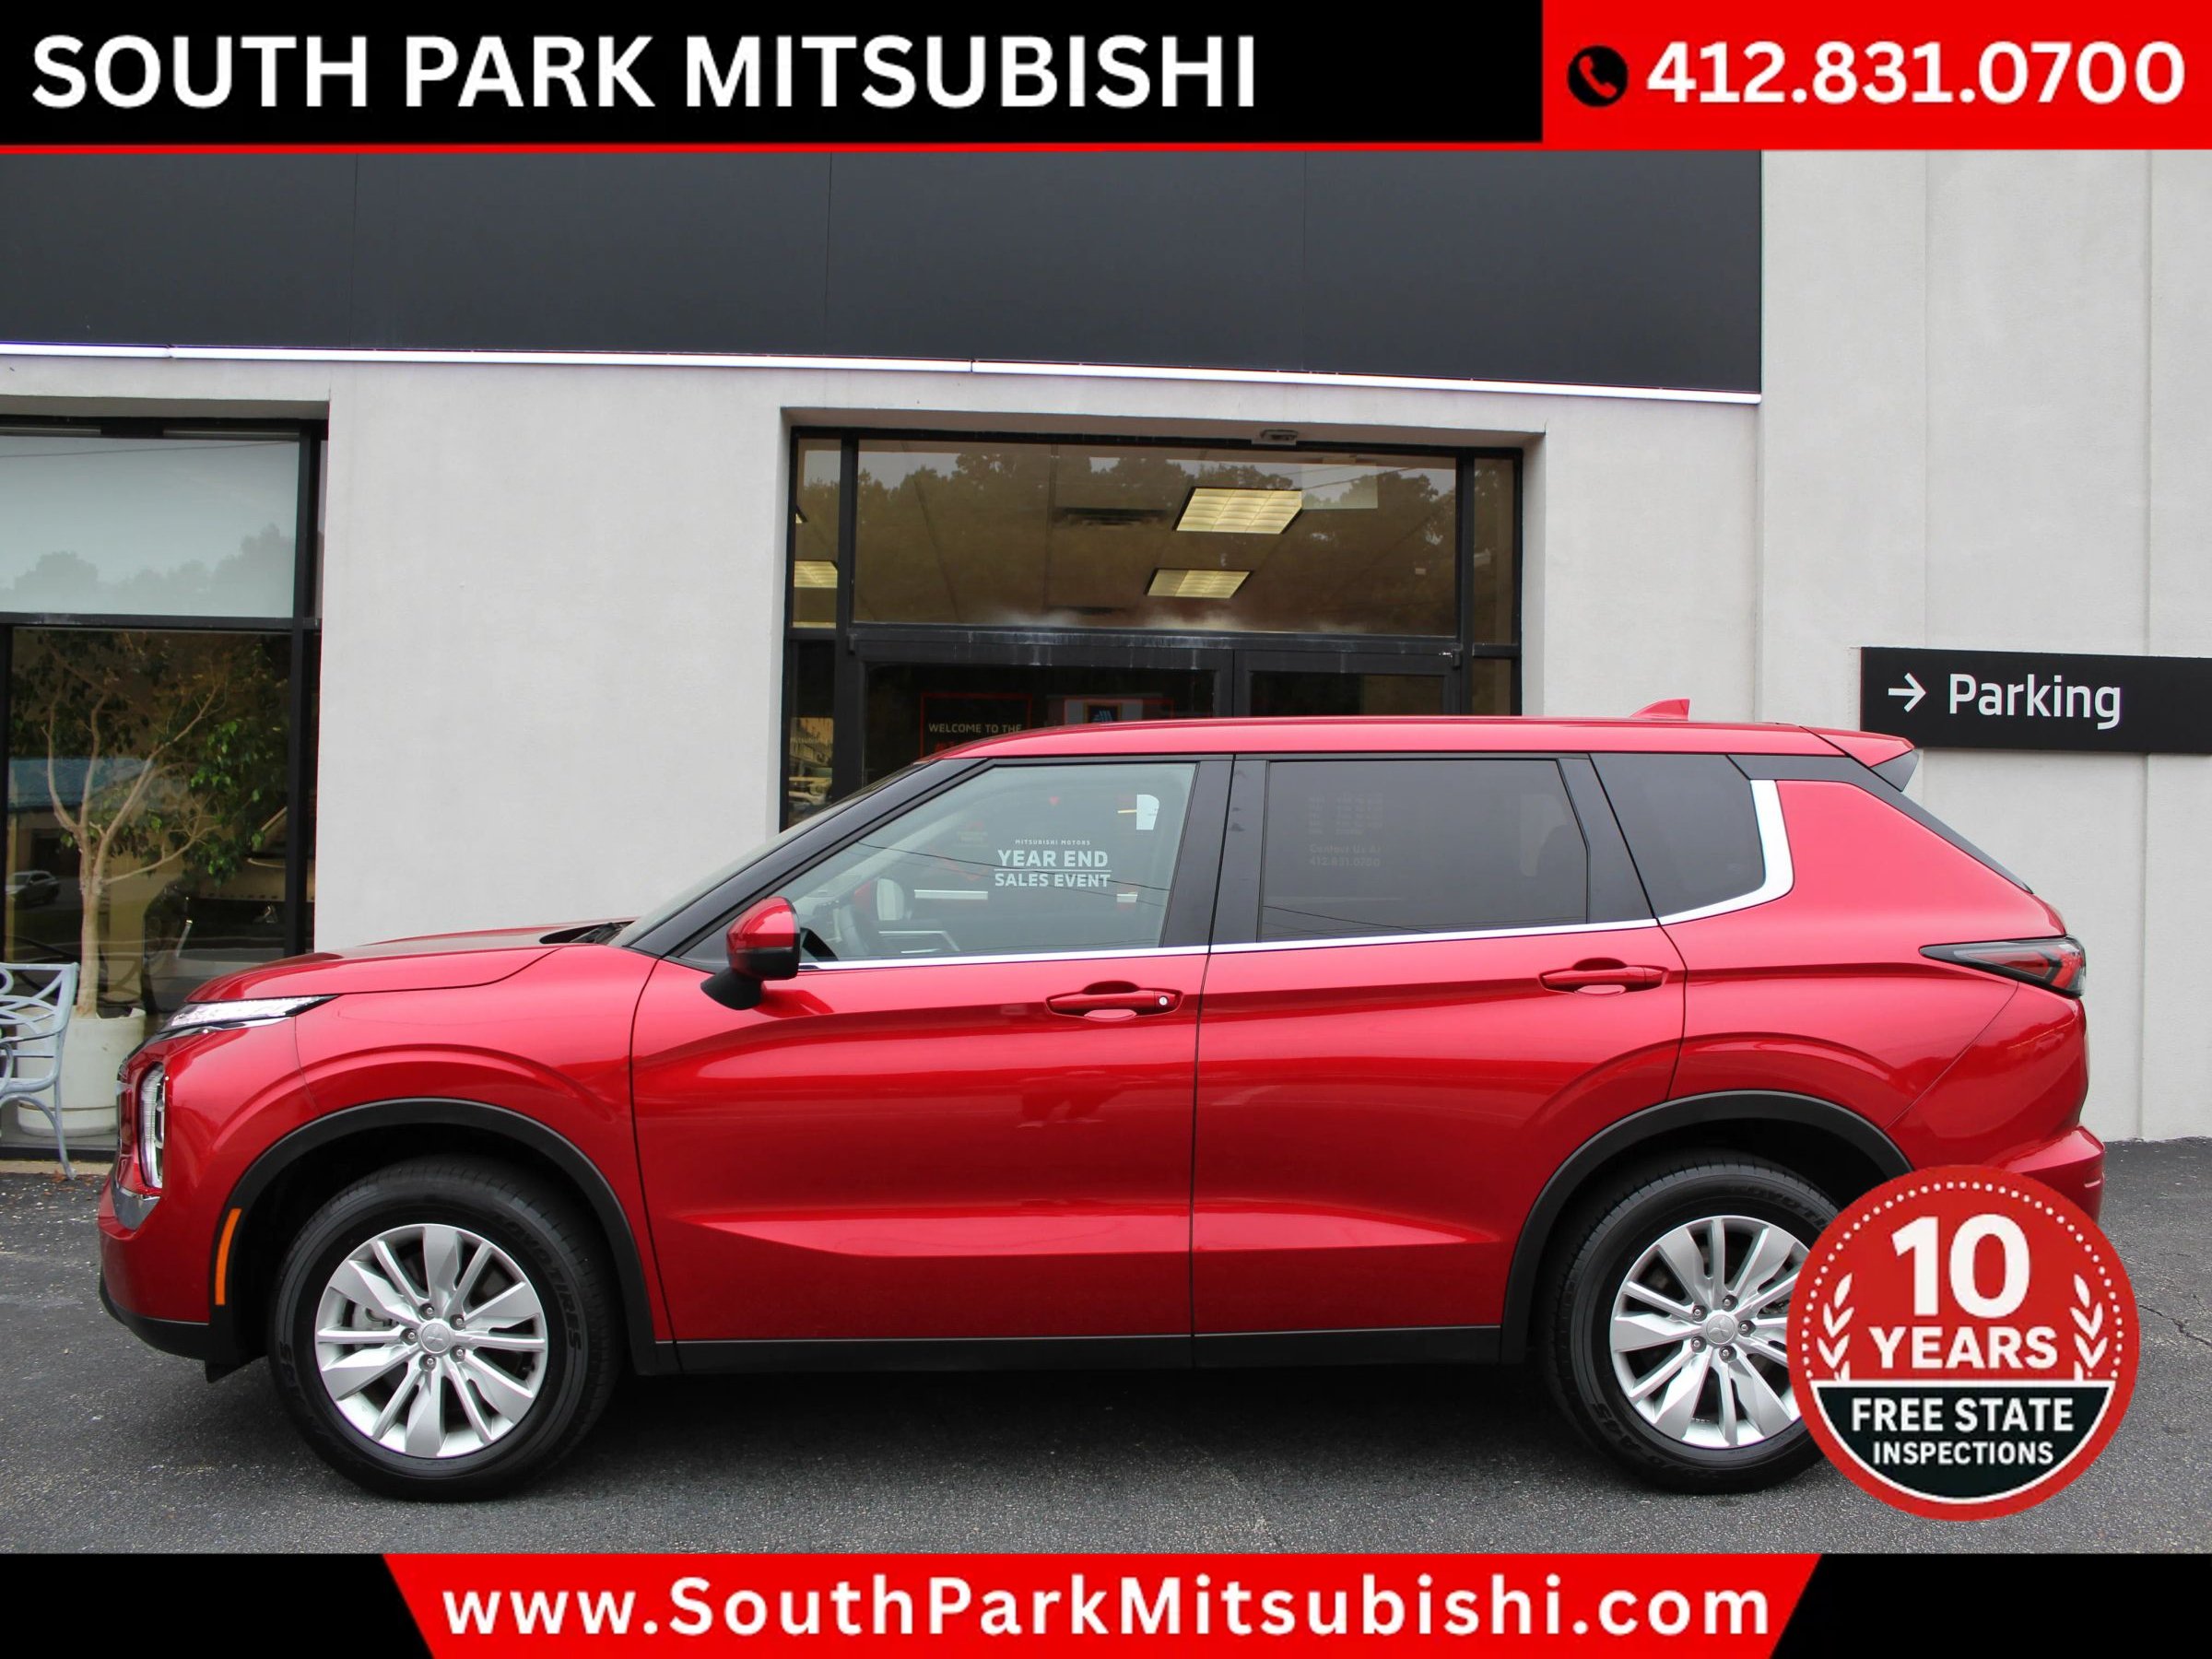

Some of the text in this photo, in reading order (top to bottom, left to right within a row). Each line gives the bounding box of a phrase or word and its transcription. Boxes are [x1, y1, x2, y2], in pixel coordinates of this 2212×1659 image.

[1948, 673, 2121, 730] Parking
[928, 723, 982, 733] WELCOME
[984, 724, 999, 733] TO
[997, 849, 1108, 867] YEAR END
[994, 873, 1111, 888] SALES EVENT
